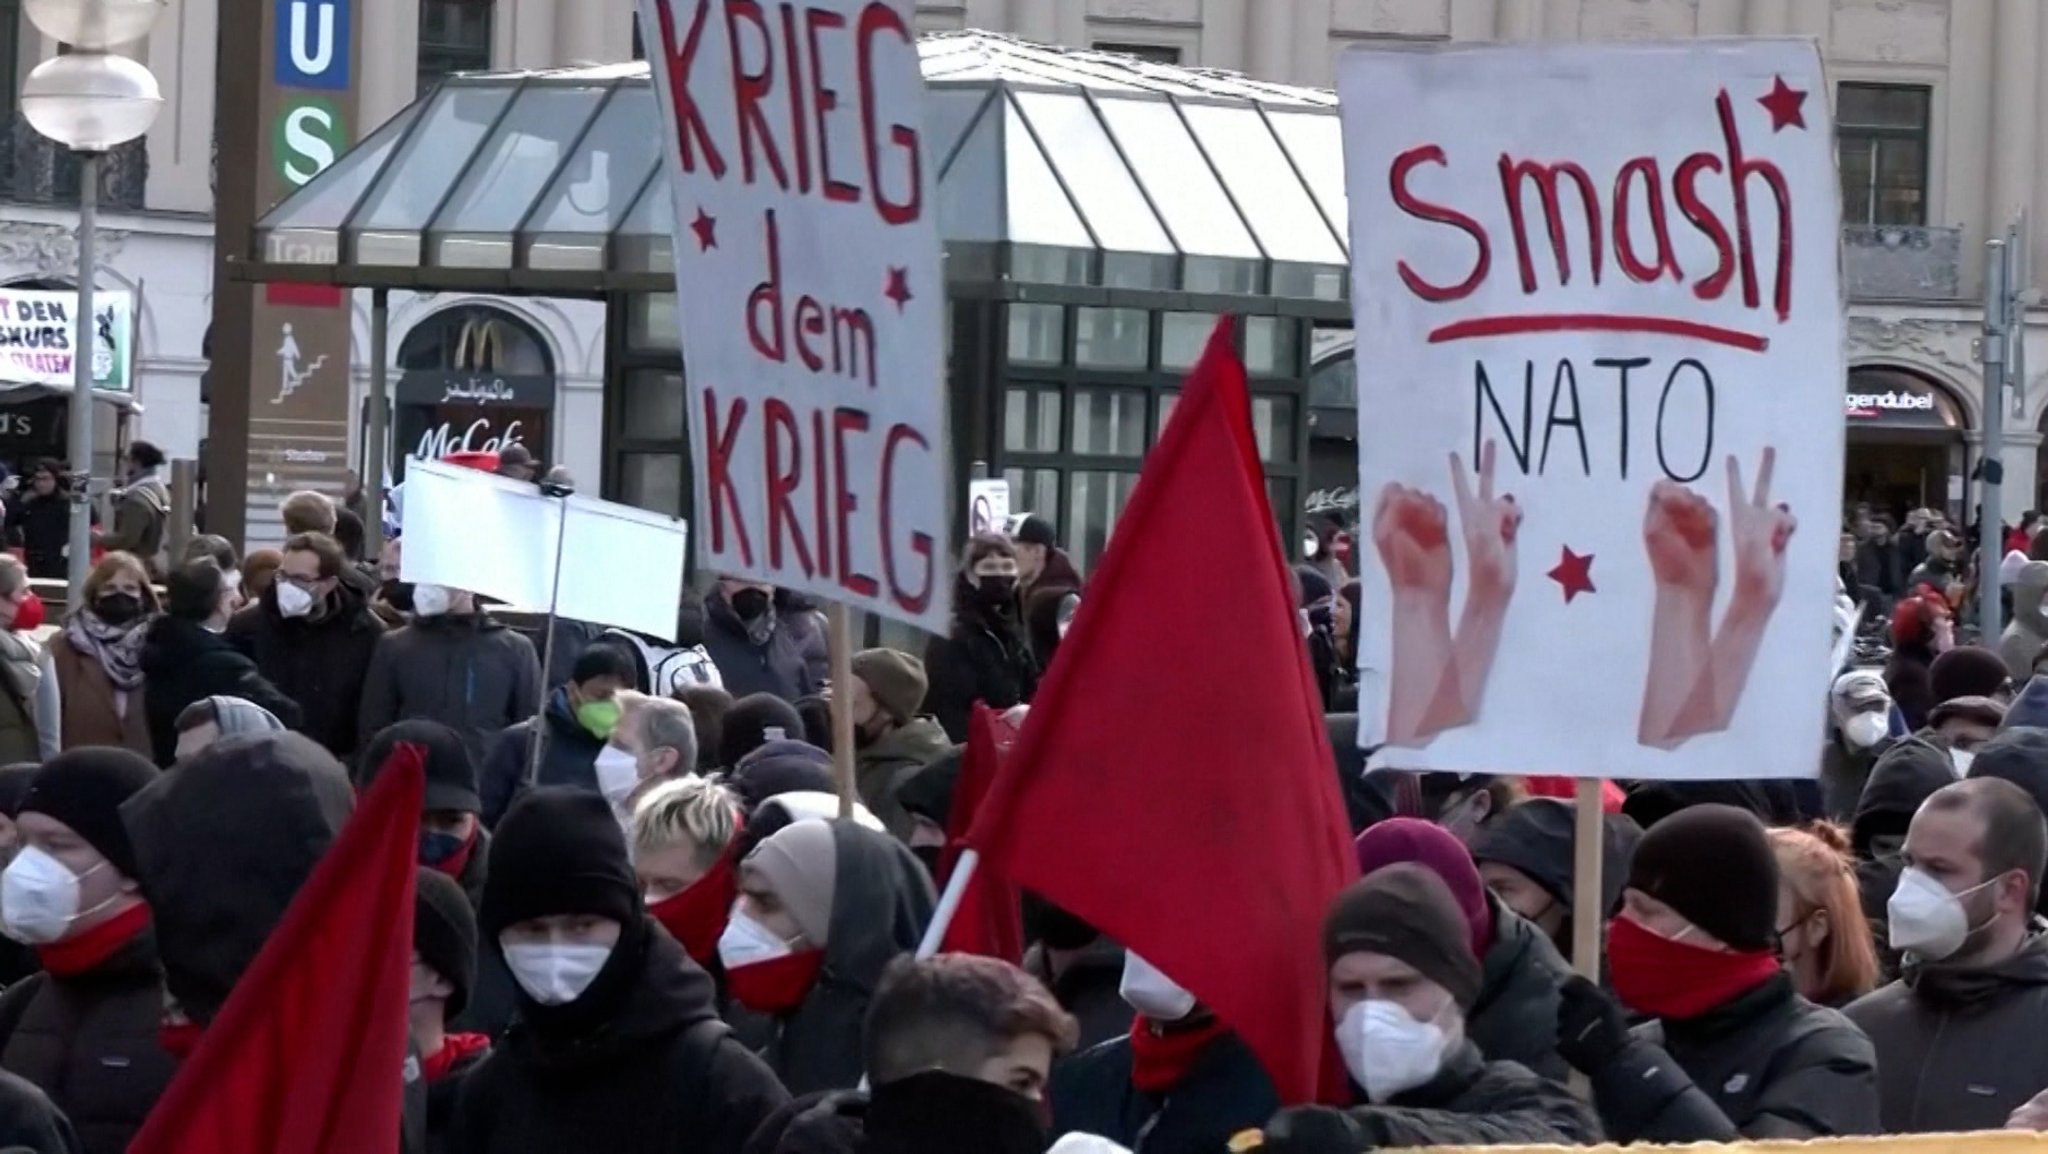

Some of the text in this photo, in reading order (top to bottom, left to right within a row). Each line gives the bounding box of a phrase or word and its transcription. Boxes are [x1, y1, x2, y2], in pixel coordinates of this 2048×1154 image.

[290, 1, 334, 75] U
[284, 106, 334, 185] S
[655, 0, 922, 225] KRIEG
[270, 235, 338, 264] Tram
[745, 208, 878, 387] dem
[16, 301, 67, 322] DEN
[1472, 358, 1715, 482] NATO
[703, 386, 935, 615] KRIEG
